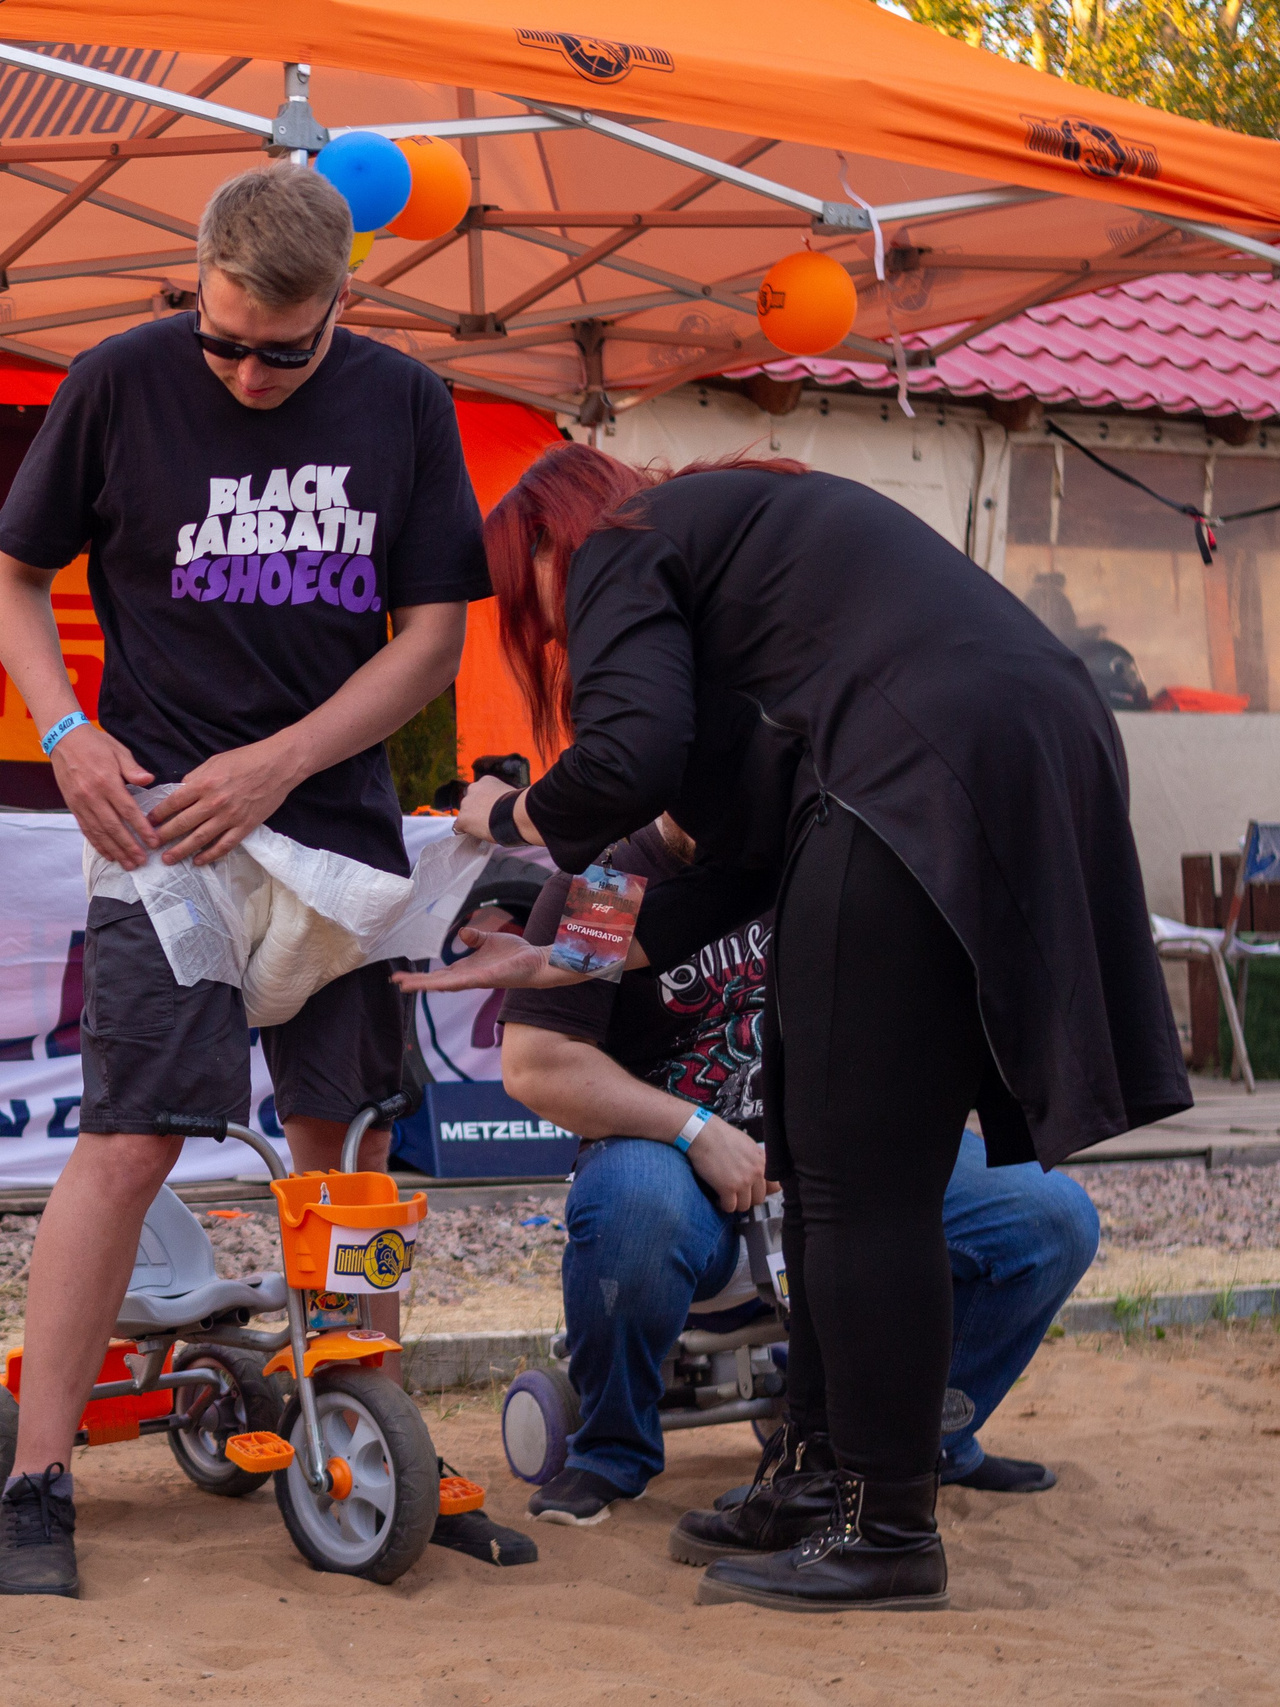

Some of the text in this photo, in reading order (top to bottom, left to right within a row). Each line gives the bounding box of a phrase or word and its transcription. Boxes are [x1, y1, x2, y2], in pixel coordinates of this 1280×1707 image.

[207, 464, 351, 518] BLACK
[175, 507, 377, 566] SABBATH
[566, 923, 623, 943] ОРГАНИЗАТОР
[336, 1246, 365, 1273] БАЙК
